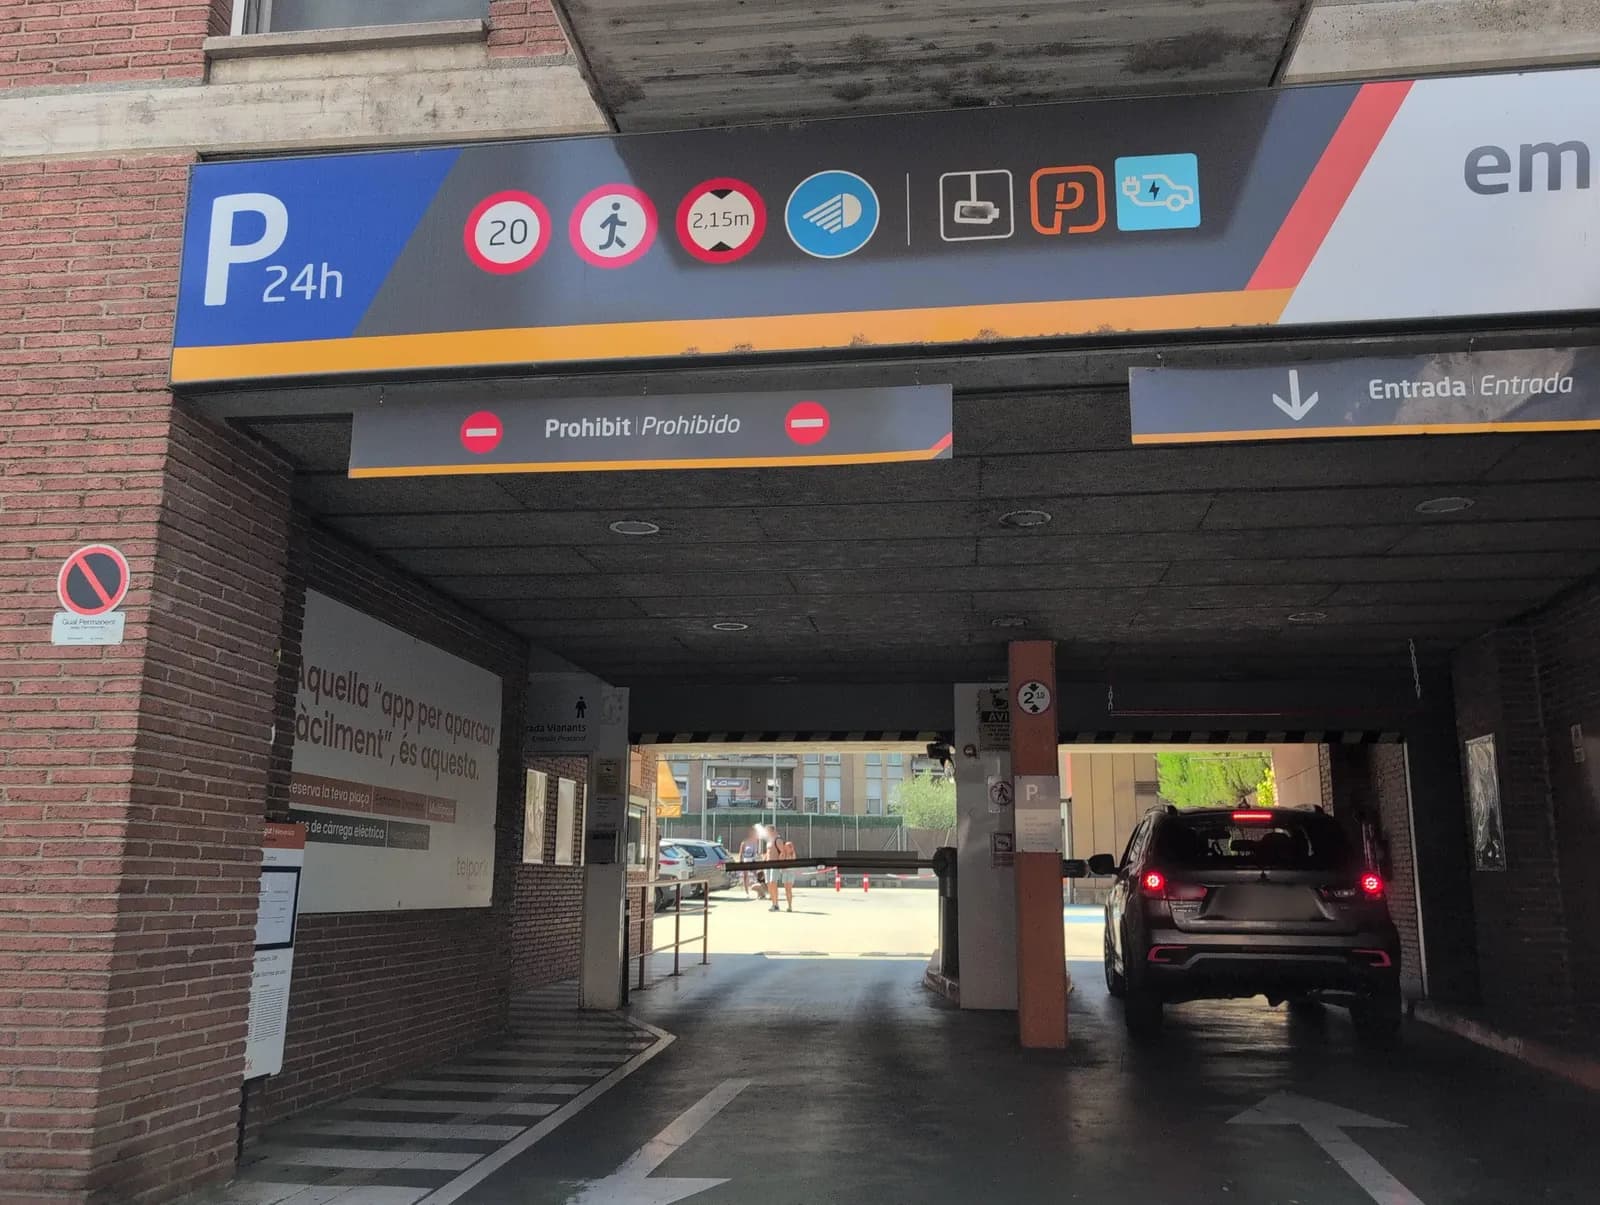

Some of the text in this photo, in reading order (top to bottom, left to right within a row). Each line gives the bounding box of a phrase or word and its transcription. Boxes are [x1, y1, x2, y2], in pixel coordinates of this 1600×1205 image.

[1463, 139, 1591, 196] em
[488, 217, 529, 247] 20
[691, 210, 751, 230] 2,15m
[203, 192, 289, 307] P
[262, 261, 344, 304] 24h
[1368, 371, 1575, 401] Entrada Entrada
[544, 413, 742, 439] Prohibit Prohibido
[417, 701, 443, 735] per
[445, 710, 496, 746] aparcar
[526, 724, 544, 733] rada
[989, 711, 1009, 722] AVI
[295, 703, 480, 782] àcilment", és aquesta.
[322, 784, 330, 798] la
[331, 788, 348, 802] teva
[1025, 783, 1039, 801] P
[311, 819, 321, 833] de
[322, 821, 353, 841] càrrega
[354, 823, 385, 840] elèctrica
